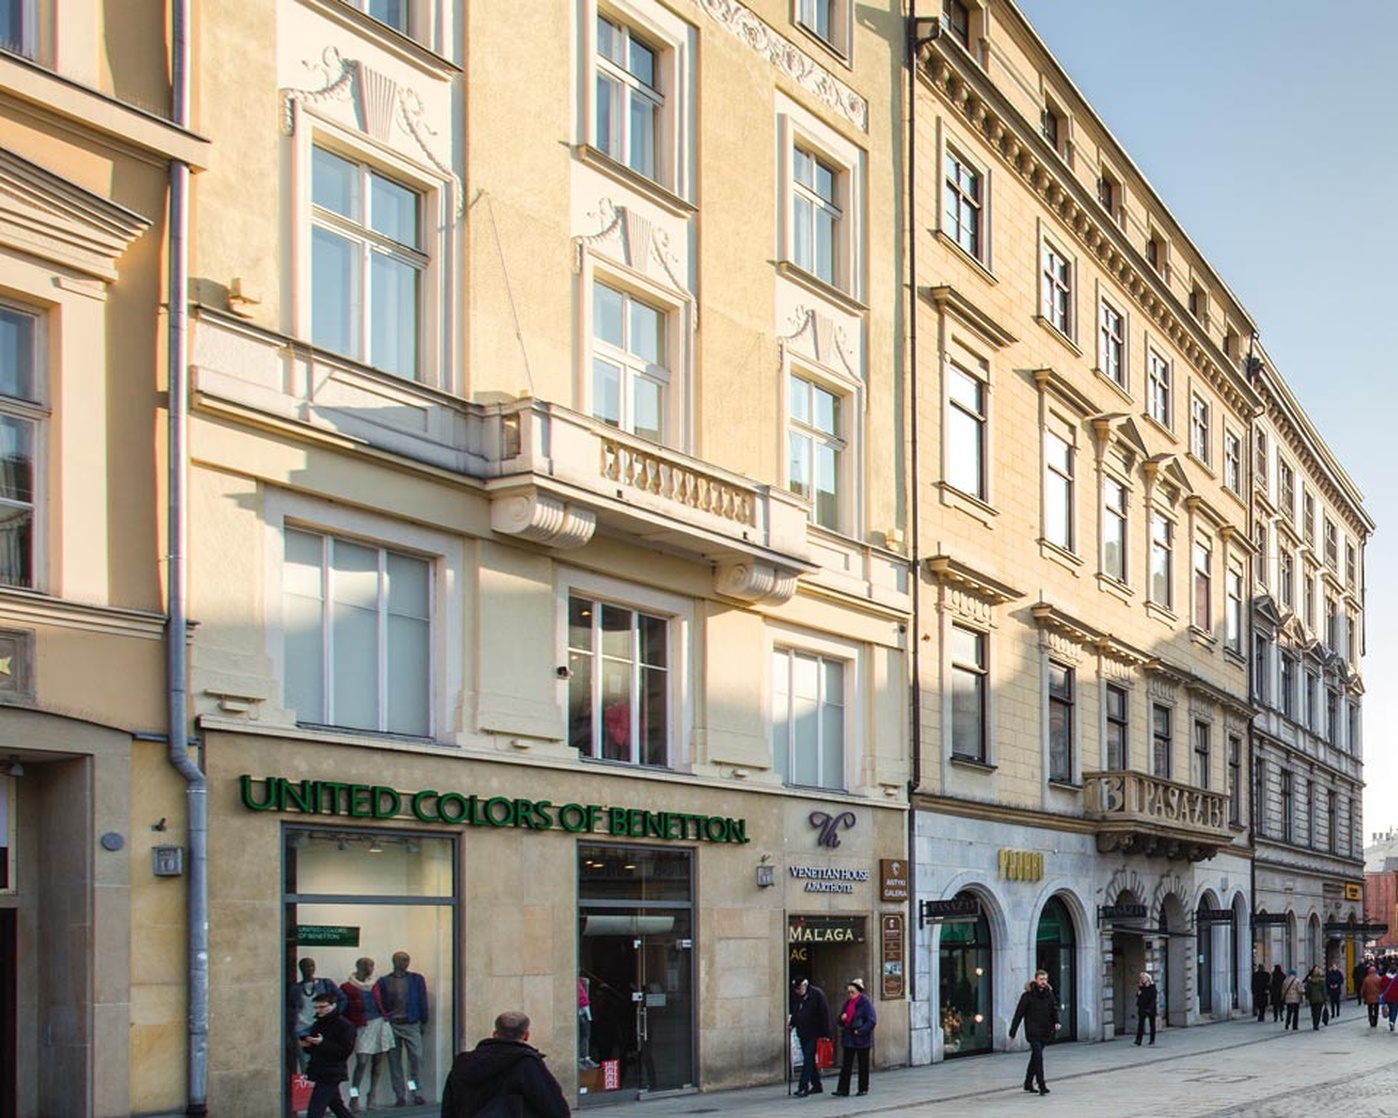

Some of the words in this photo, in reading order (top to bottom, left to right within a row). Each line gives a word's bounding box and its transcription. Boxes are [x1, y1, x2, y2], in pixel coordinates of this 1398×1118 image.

[240, 774, 402, 818] UNITED
[412, 789, 553, 831] COLORS
[559, 803, 603, 832] OF
[789, 866, 839, 880] VENETIAN
[840, 868, 870, 882] HOUSE
[789, 926, 854, 942] MALAGA
